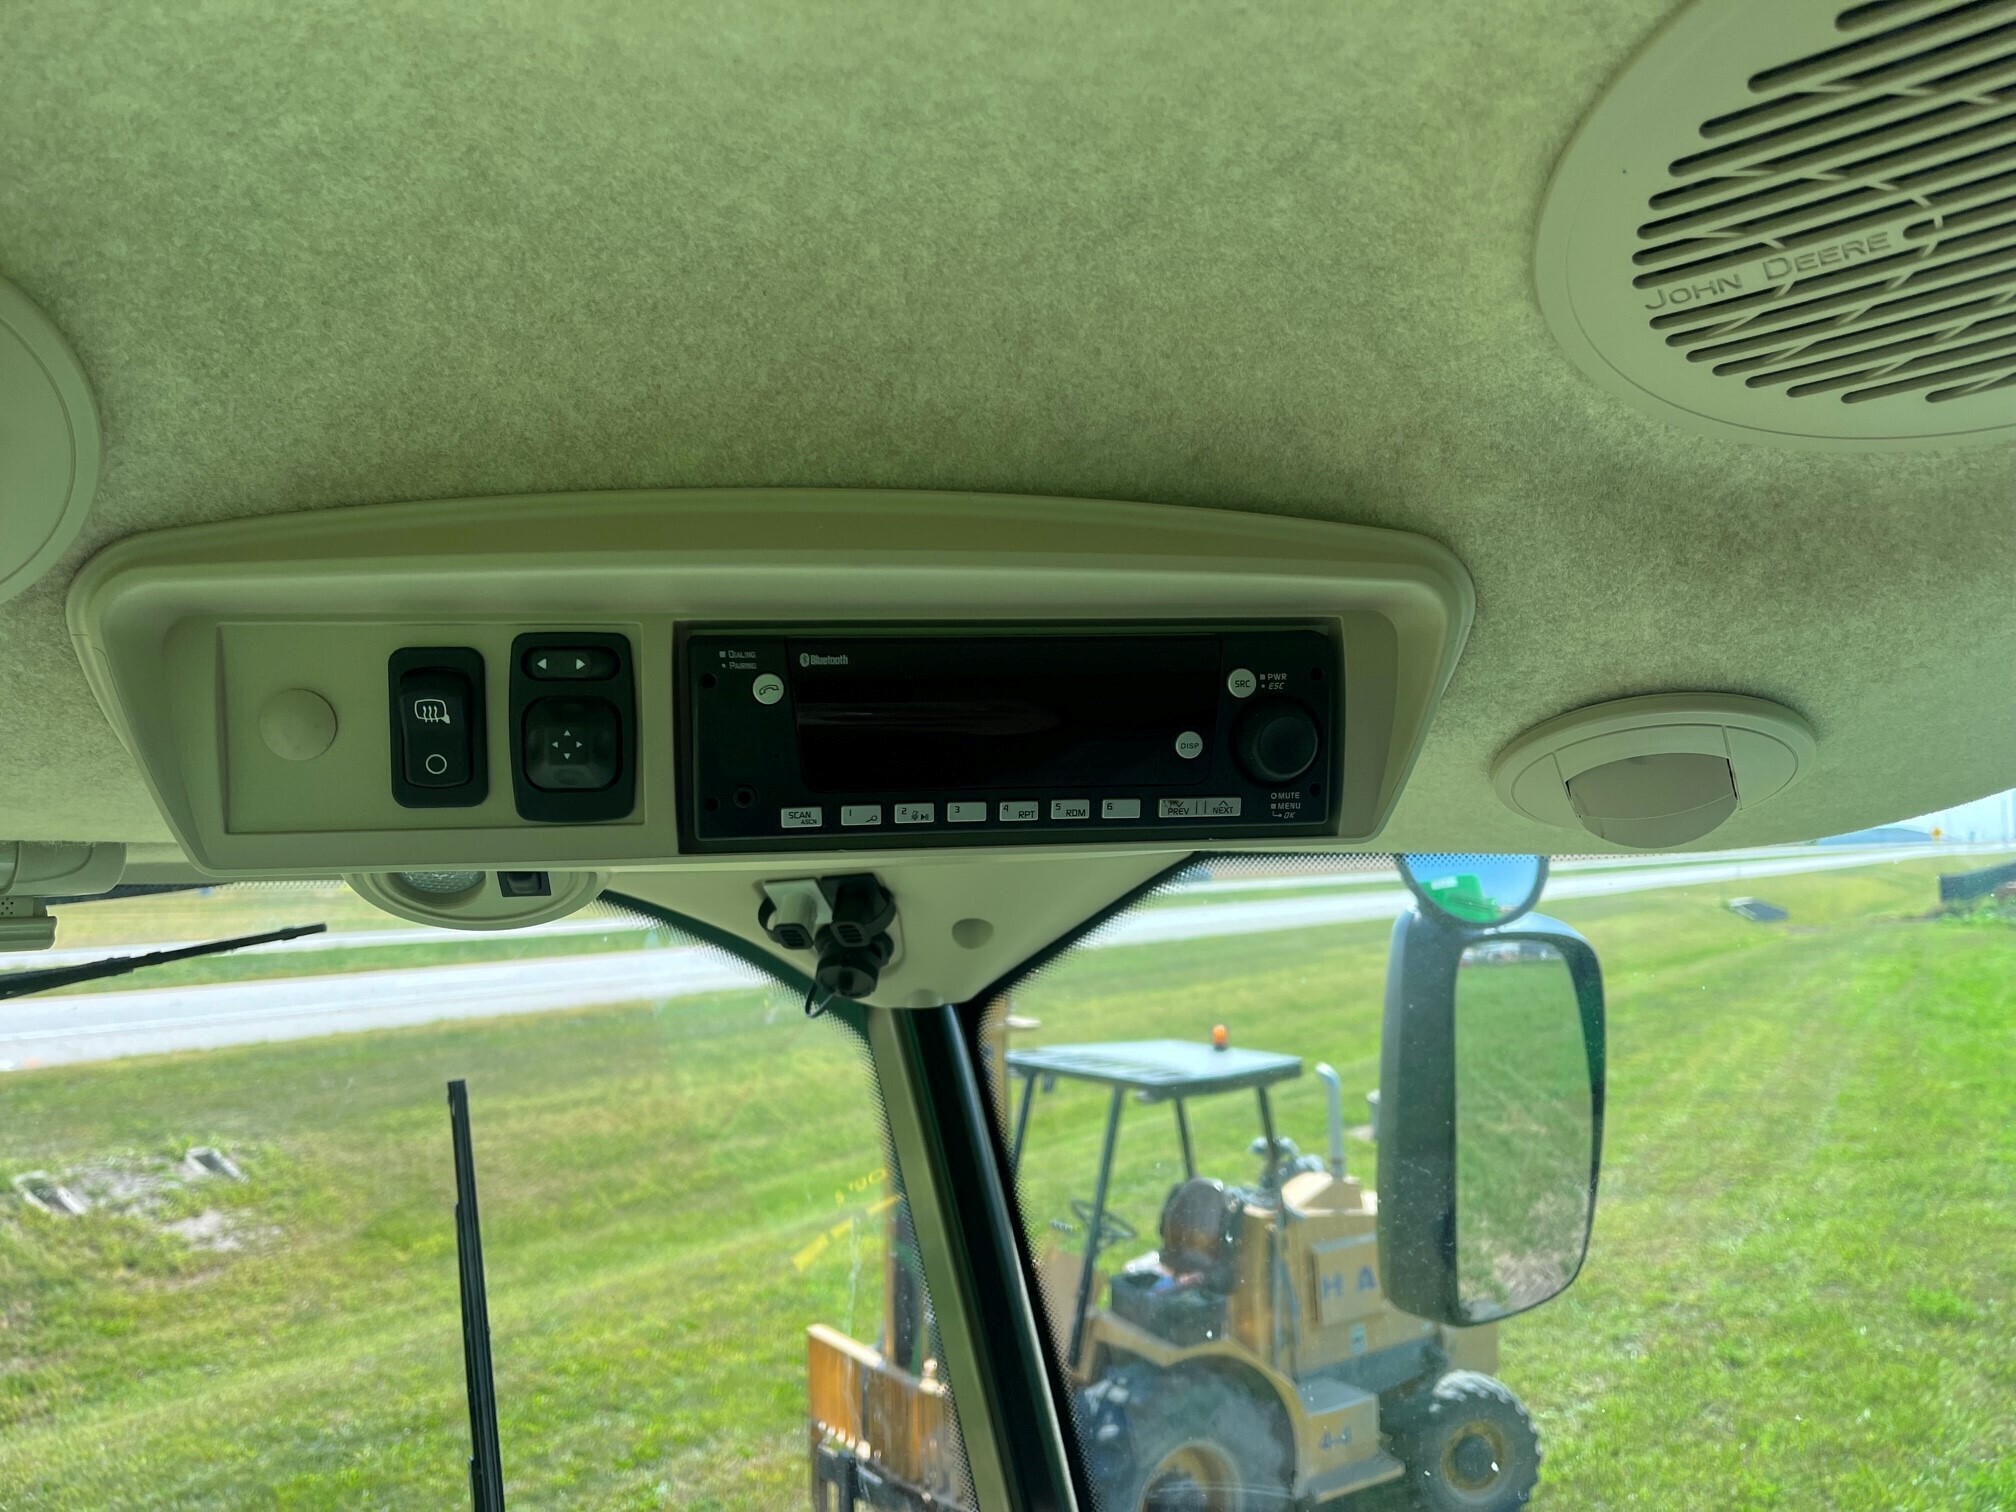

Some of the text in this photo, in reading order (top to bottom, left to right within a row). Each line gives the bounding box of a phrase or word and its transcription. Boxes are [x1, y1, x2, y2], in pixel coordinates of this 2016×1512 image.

[1644, 231, 1892, 310] JOHN DEERE
[810, 654, 849, 666] Bluetooth
[729, 661, 758, 670] PAIRING
[1267, 673, 1287, 681] PWR
[1234, 680, 1251, 688] SRC
[1267, 682, 1285, 690] ESC
[1180, 742, 1200, 750] DISP
[1278, 792, 1300, 800] MUTE
[954, 805, 961, 814] 3
[1003, 804, 1009, 813] 4
[1055, 802, 1062, 811] 5
[1107, 802, 1113, 811] 6
[1212, 806, 1234, 815] NEXT
[1277, 802, 1301, 810] MENU
[788, 811, 812, 820] SCAN
[901, 807, 908, 815] 2
[1018, 810, 1036, 819] RPT
[1065, 808, 1086, 818] RDM
[1167, 807, 1190, 816] PREV
[1283, 811, 1296, 820] OK
